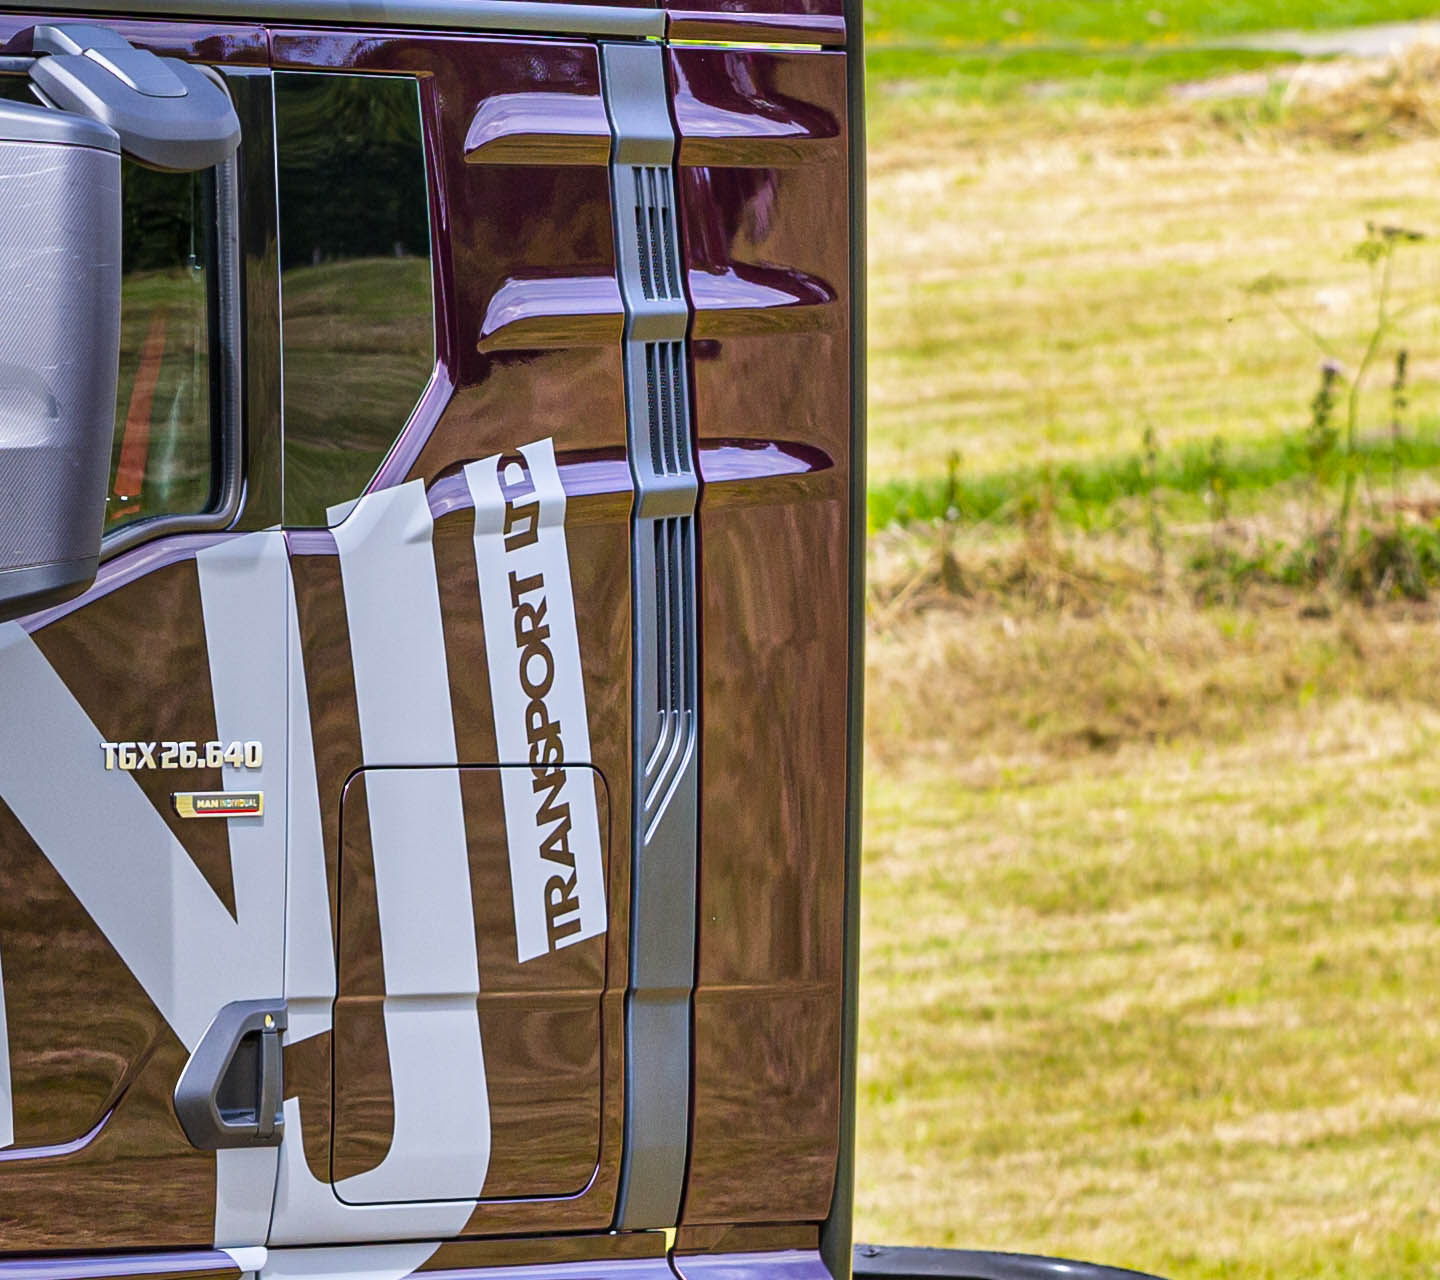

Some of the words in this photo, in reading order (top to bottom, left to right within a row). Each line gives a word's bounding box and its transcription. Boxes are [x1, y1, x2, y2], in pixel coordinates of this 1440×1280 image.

[496, 453, 540, 552] LTD
[100, 741, 157, 770] TGX
[160, 740, 264, 769] 26.640
[508, 570, 582, 952] TRANSPORT
[196, 798, 219, 809] MAN
